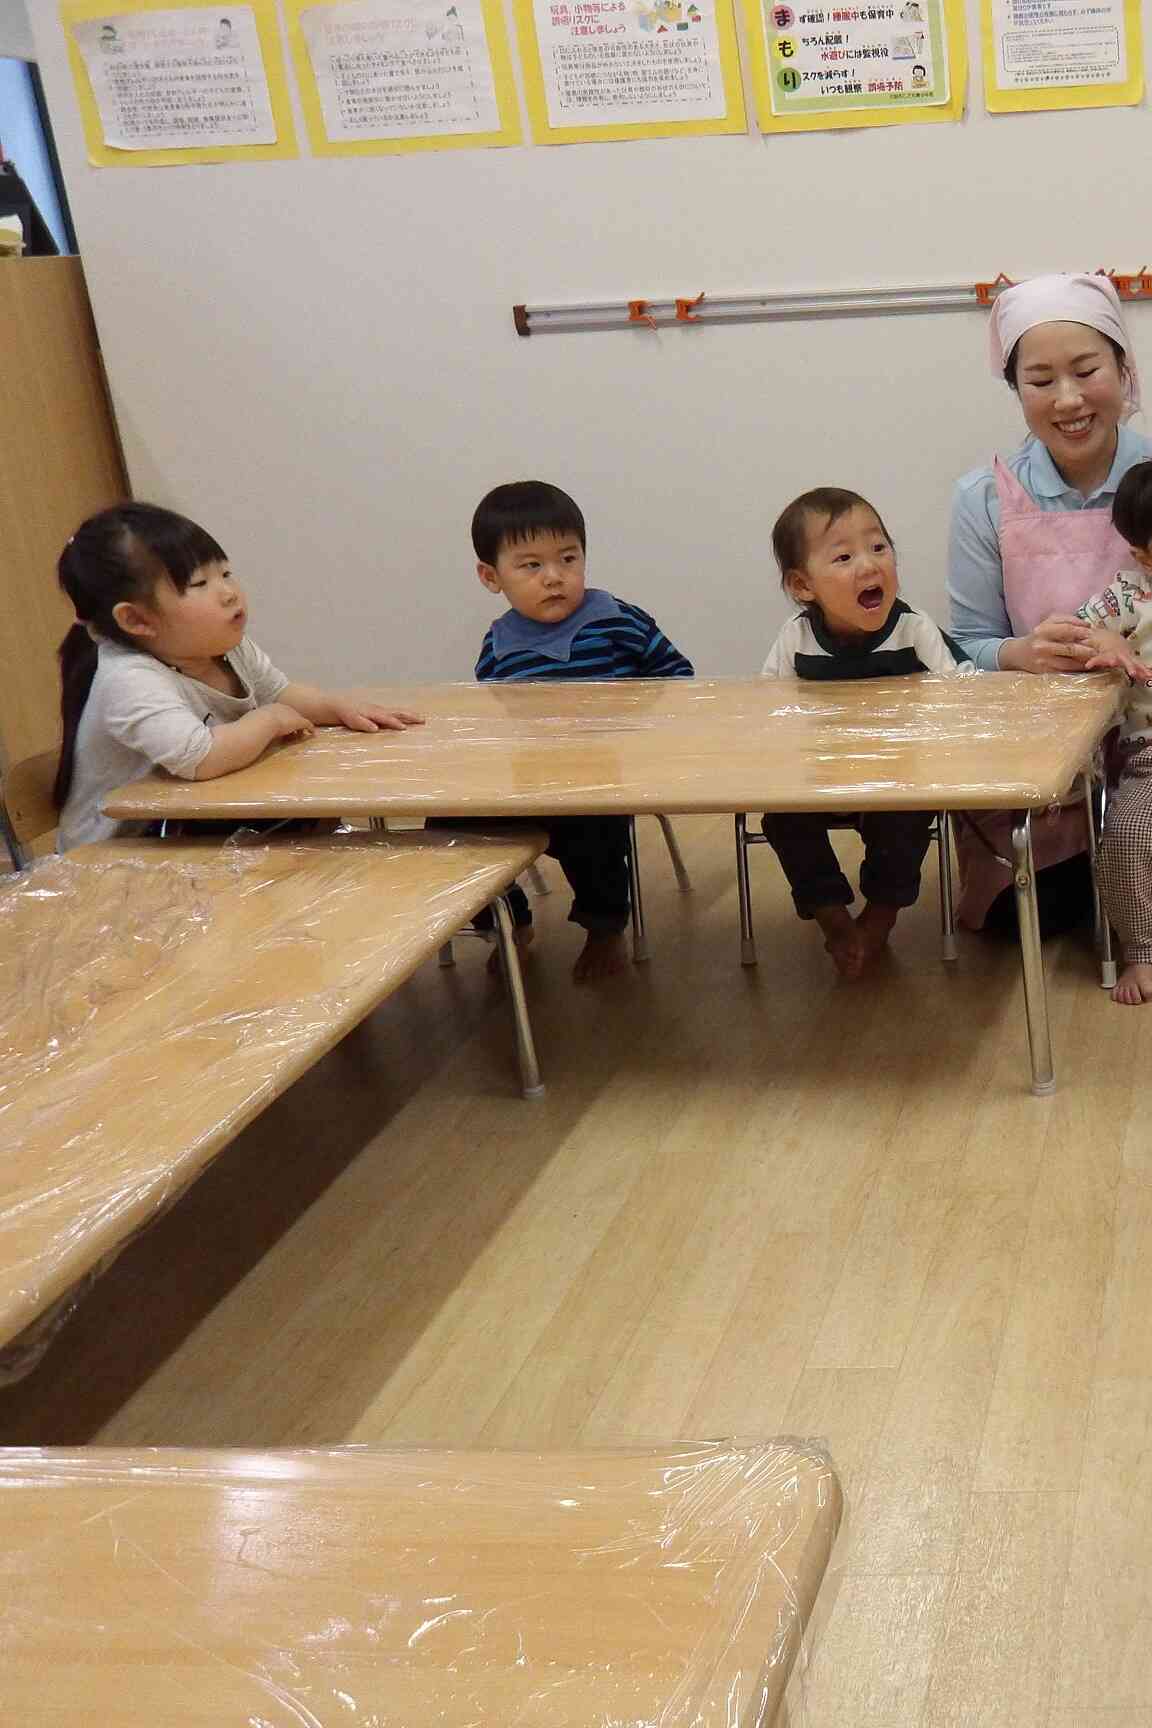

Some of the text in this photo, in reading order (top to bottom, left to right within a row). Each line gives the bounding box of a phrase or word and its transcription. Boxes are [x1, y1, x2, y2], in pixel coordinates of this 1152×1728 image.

[775, 9, 790, 26] ま
[778, 40, 794, 57] も
[783, 71, 795, 88] り
